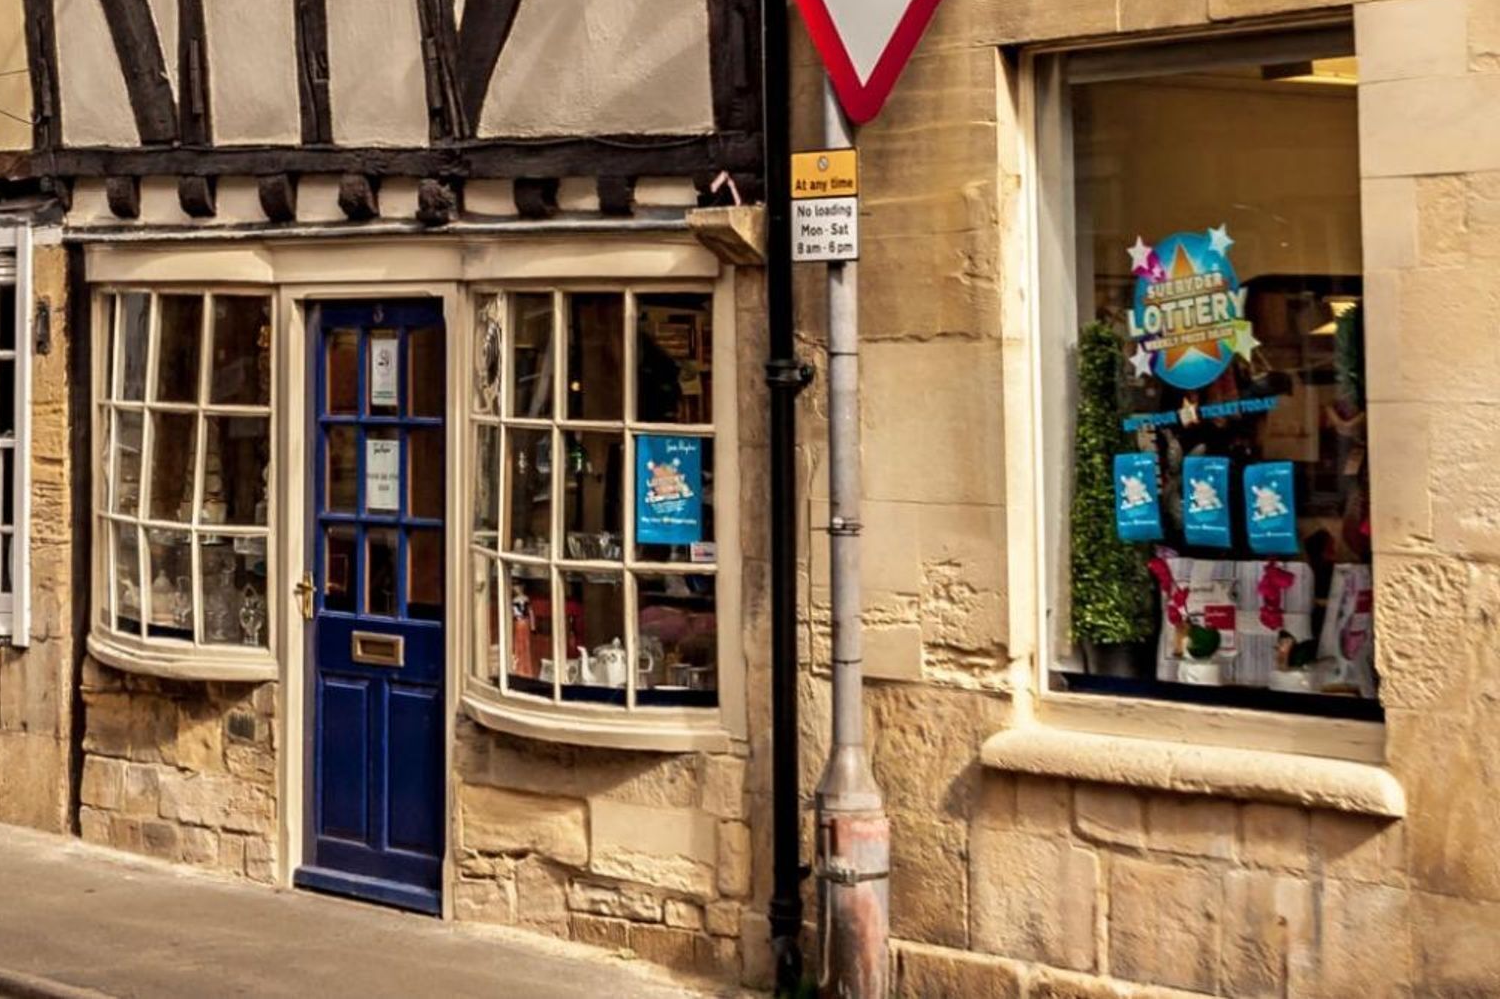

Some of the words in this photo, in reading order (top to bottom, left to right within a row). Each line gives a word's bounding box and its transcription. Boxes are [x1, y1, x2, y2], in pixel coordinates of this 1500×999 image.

[795, 178, 807, 191] At
[809, 179, 828, 193] any
[831, 176, 853, 189] time
[797, 205, 812, 218] No
[815, 203, 852, 218] loading
[801, 224, 823, 237] Mon
[831, 223, 849, 236] Sat
[1127, 287, 1249, 337] LOTTERY
